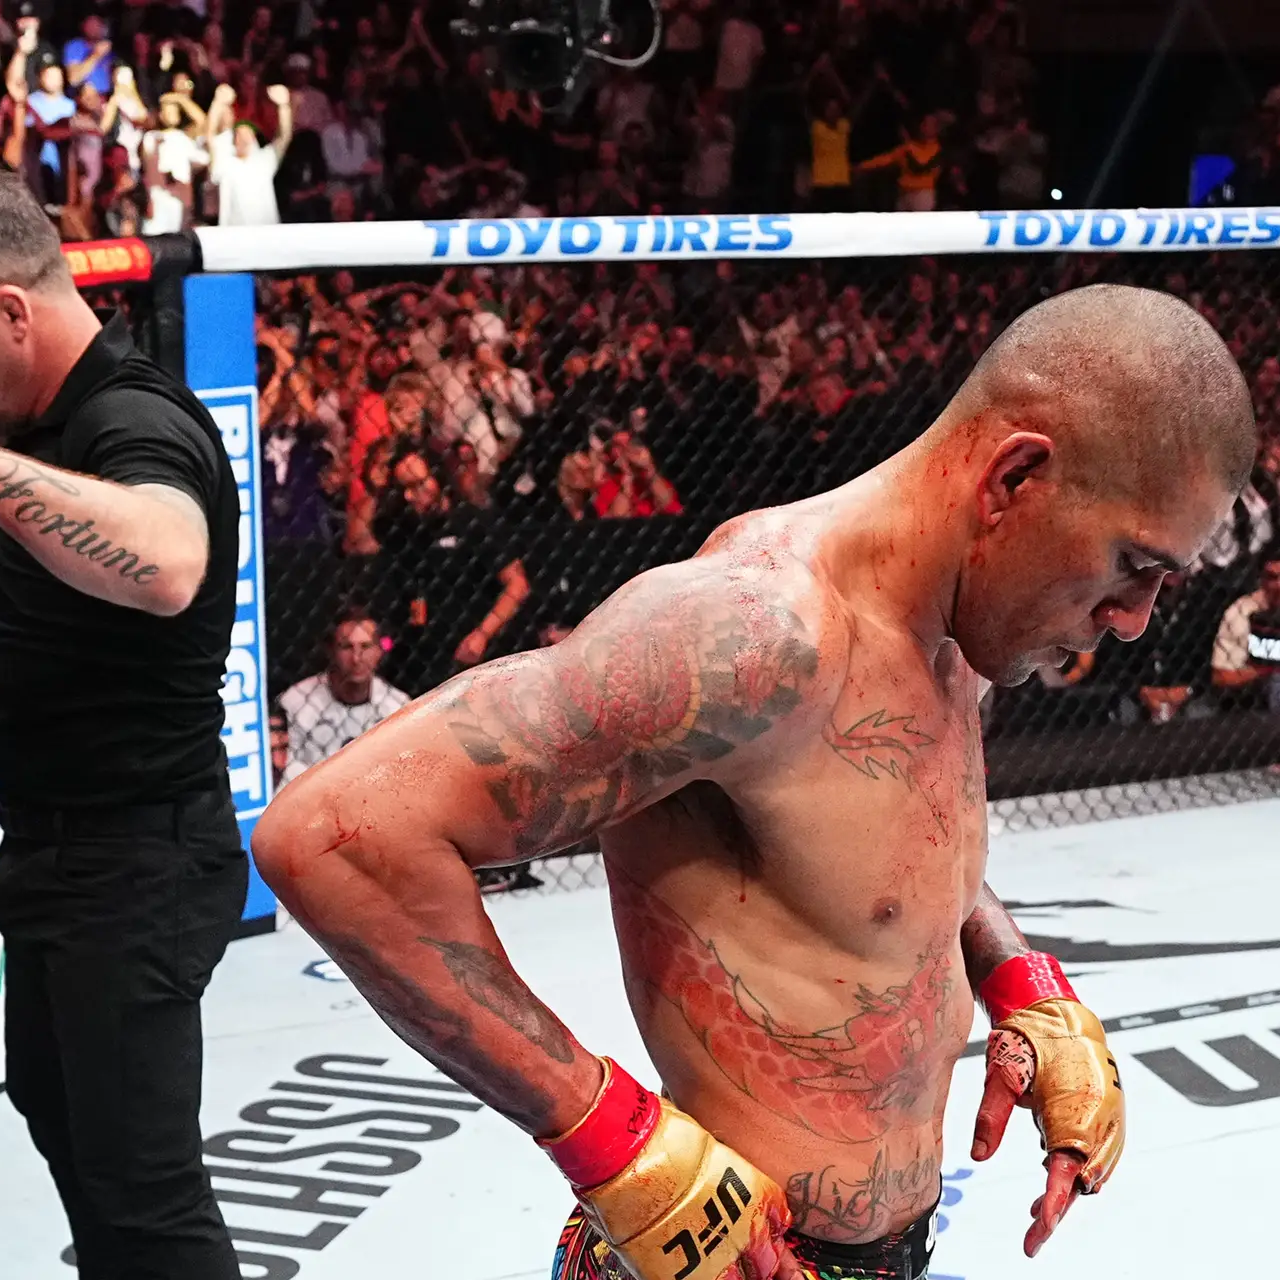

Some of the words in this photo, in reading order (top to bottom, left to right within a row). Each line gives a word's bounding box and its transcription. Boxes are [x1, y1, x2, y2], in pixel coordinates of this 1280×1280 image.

[424, 219, 603, 257] TOYO
[614, 215, 793, 253] TIRES
[978, 212, 1126, 248] TOYO
